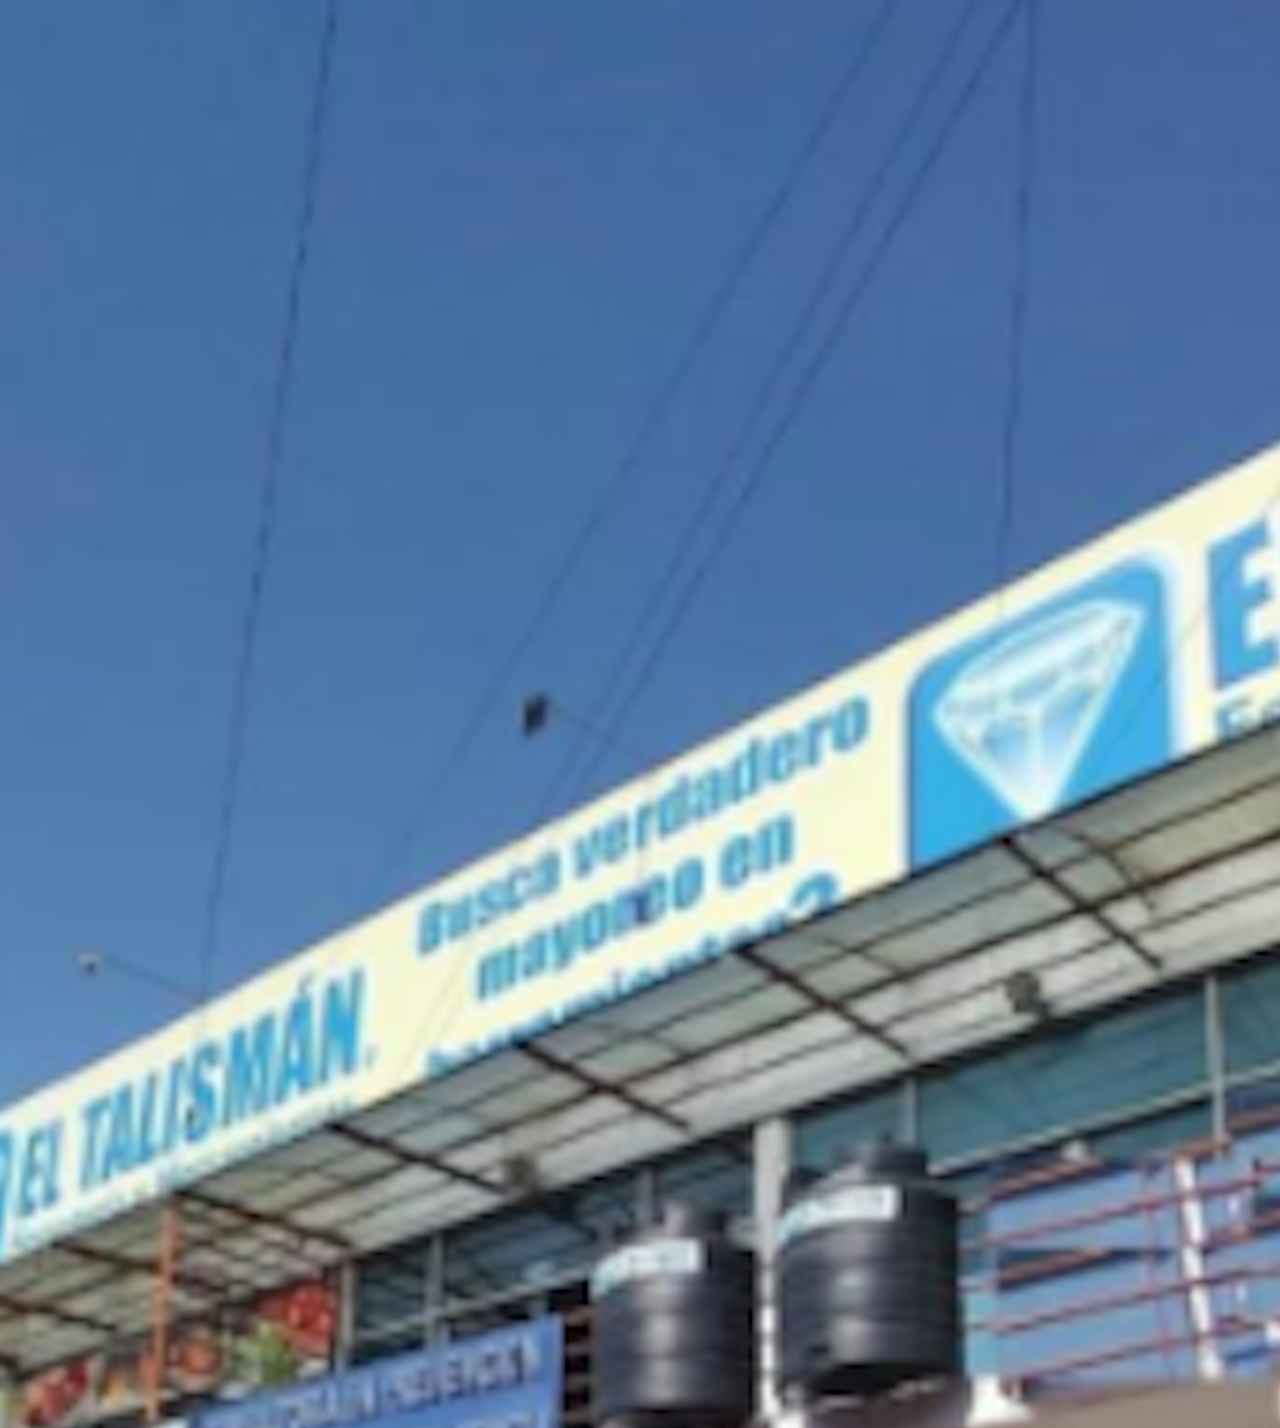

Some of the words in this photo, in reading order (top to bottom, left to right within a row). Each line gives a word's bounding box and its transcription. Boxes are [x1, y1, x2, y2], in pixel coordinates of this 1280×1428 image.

[418, 848, 562, 957] Busca
[573, 694, 870, 877] verdadero
[720, 813, 795, 890] en
[18, 1120, 60, 1217] EL
[79, 966, 364, 1190] TALISMÁN
